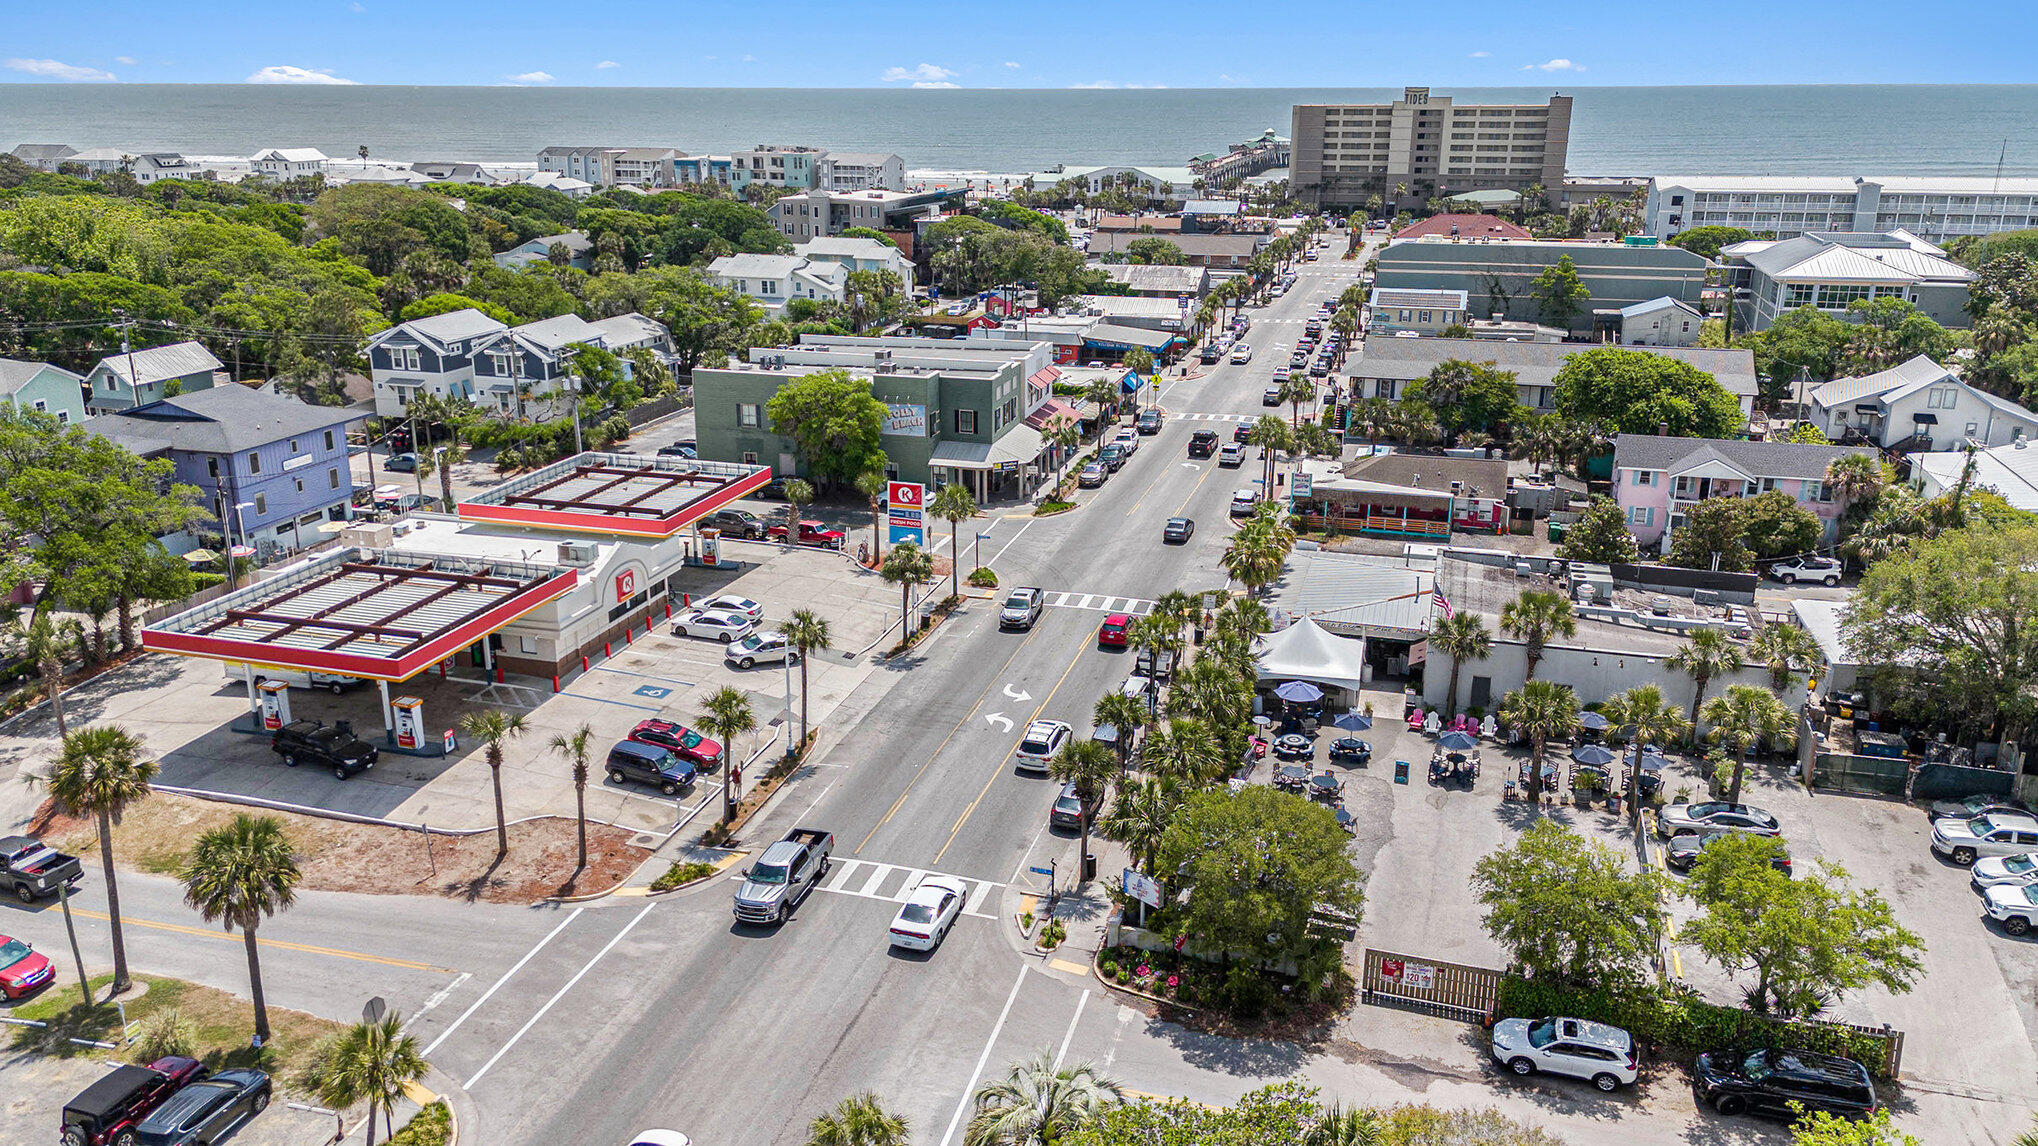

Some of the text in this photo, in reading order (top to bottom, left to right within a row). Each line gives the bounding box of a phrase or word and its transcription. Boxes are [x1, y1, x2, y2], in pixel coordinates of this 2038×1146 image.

[1404, 93, 1429, 105] TIDES
[892, 417, 924, 430] BEACH
[1406, 972, 1420, 982] $20
